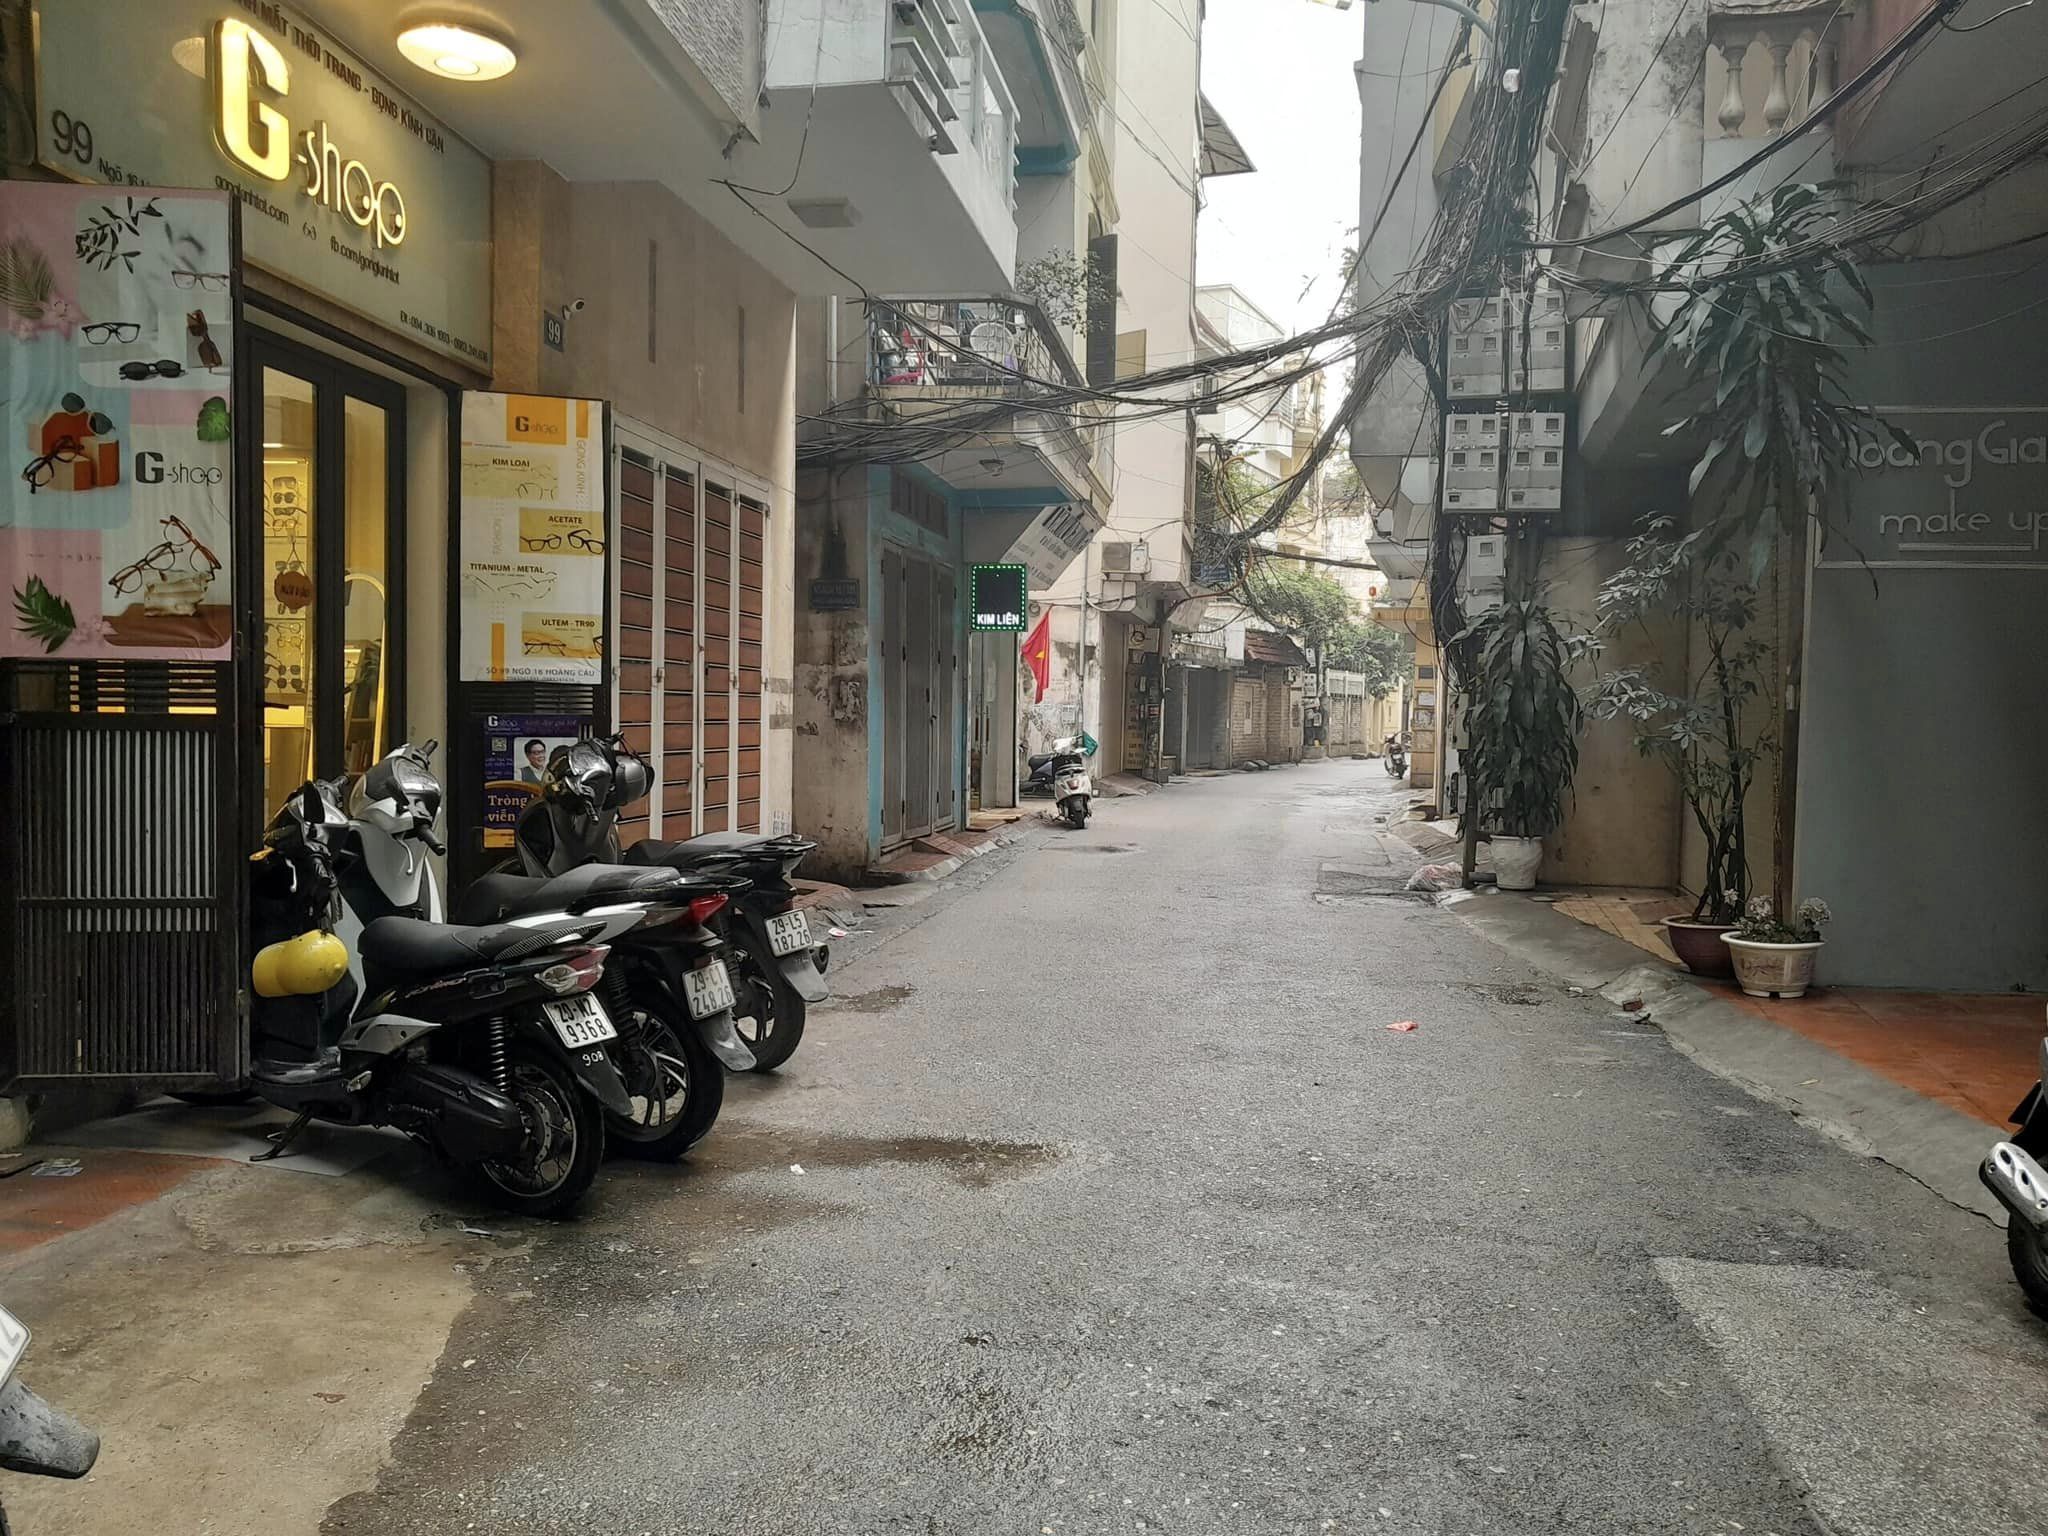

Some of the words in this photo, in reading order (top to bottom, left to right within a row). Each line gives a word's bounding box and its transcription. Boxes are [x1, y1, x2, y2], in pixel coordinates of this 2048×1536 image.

[324, 49, 362, 92] TRANG
[52, 109, 93, 164] 99
[548, 319, 561, 344] 99
[492, 457, 509, 466] KIM
[548, 515, 583, 525] ACETATE
[1879, 488, 1992, 535] make
[2008, 511, 2048, 551] up
[469, 562, 511, 572] TITANIUM
[516, 565, 545, 574] METAL
[541, 619, 569, 627] ULTEM
[575, 619, 595, 628] TR90
[977, 613, 996, 625] KIM
[997, 611, 1020, 625] LIÊN
[487, 794, 528, 809] Tròng
[771, 914, 803, 936] 29-L5
[774, 930, 811, 954] 182.26
[566, 1017, 609, 1043] 9368
